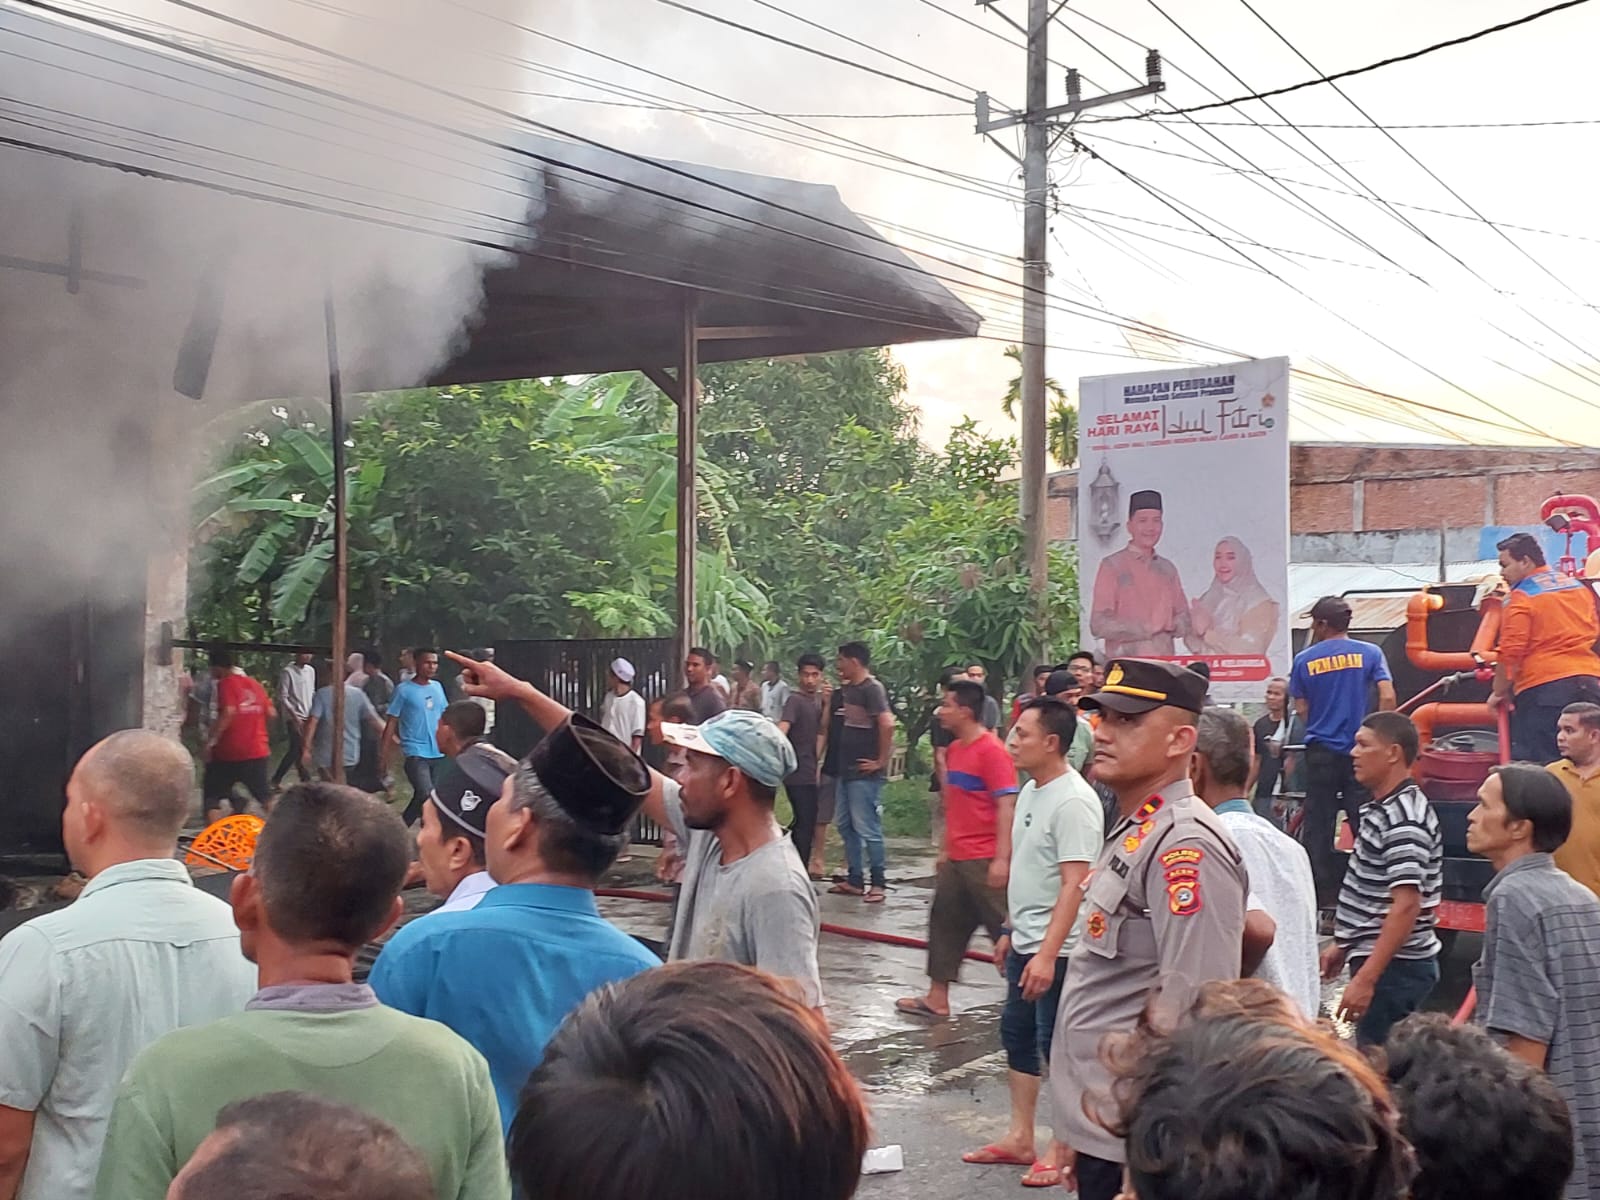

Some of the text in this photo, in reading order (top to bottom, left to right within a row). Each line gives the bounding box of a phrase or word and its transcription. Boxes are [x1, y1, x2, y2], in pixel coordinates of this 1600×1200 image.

[1124, 382, 1170, 396] HARAPAN
[1173, 375, 1235, 391] PERUBAHAN
[1097, 410, 1160, 425] SELAMAT
[1087, 422, 1159, 437] HARI RAYA
[1307, 653, 1364, 676] PEMADAM
